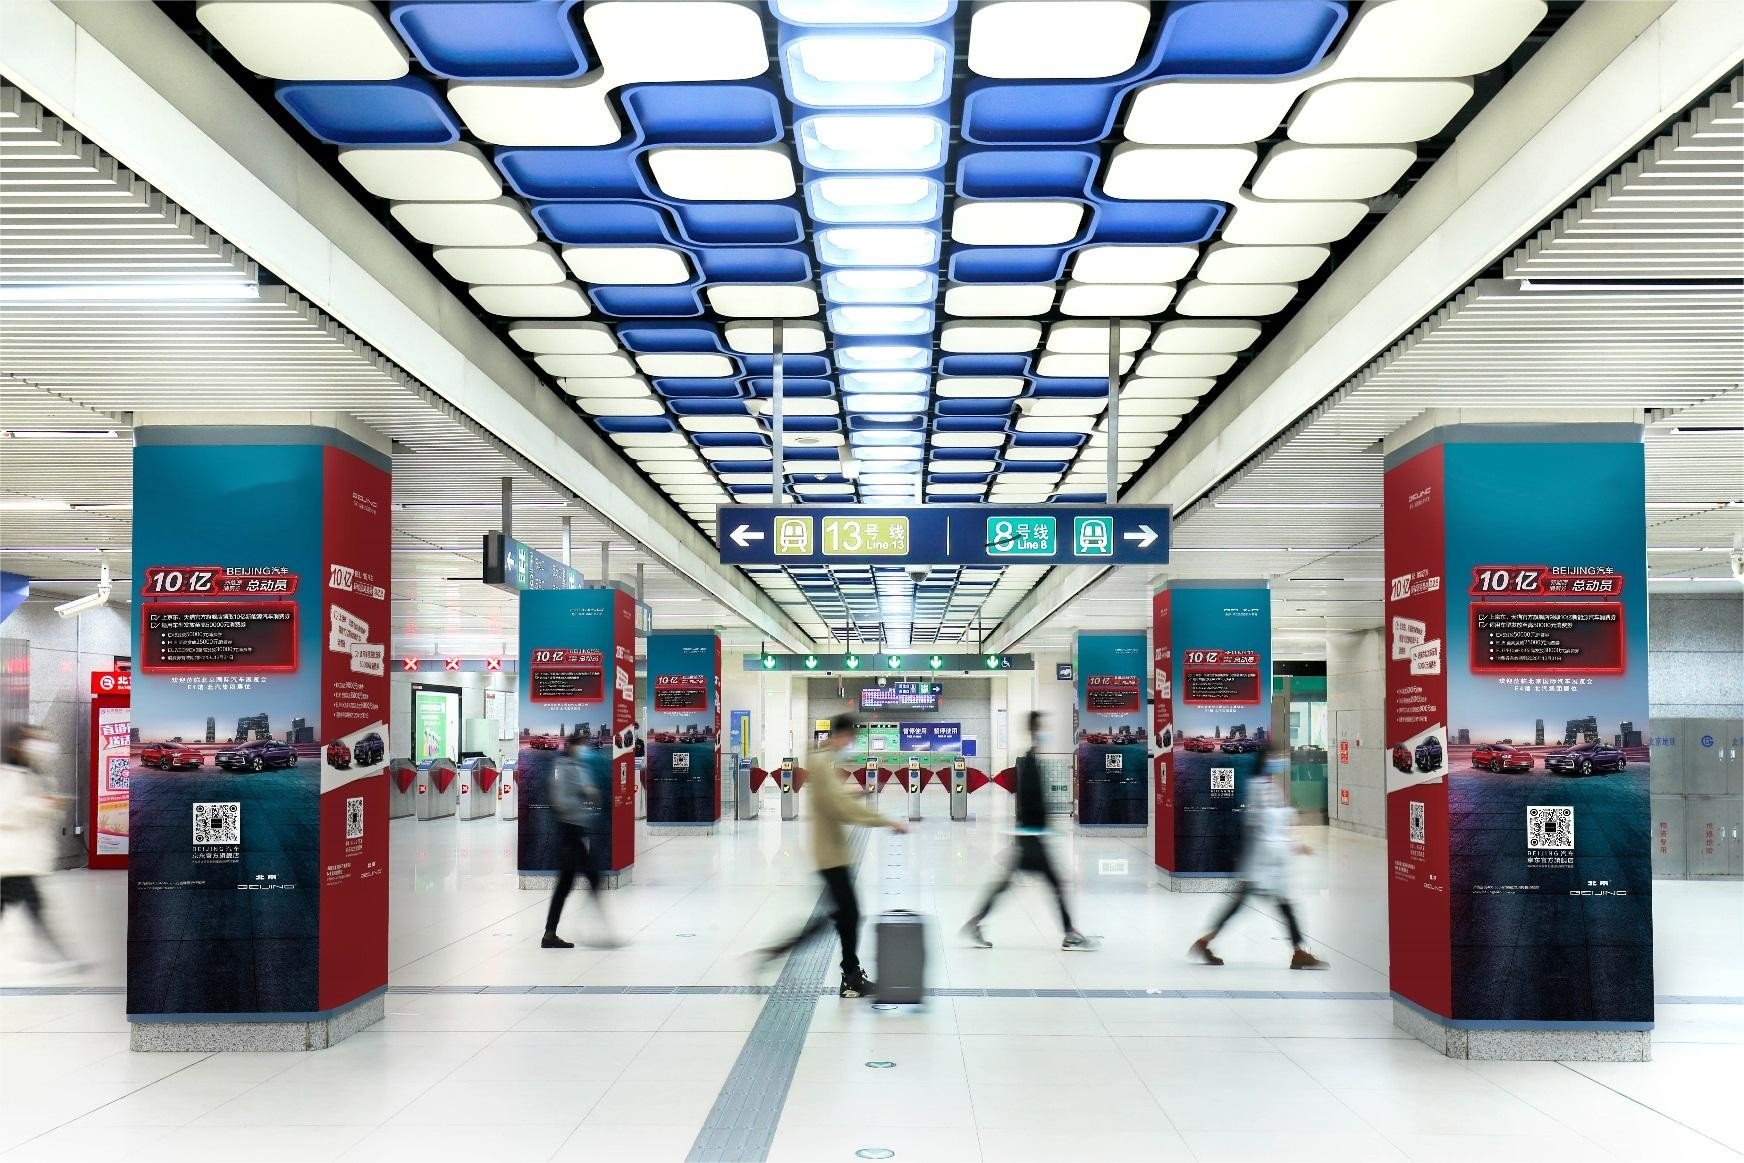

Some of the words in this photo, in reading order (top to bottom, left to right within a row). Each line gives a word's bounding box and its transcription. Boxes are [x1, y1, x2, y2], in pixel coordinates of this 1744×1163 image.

[826, 521, 904, 551] 13号线
[993, 521, 1048, 552] 8号线
[866, 540, 889, 550] Line
[892, 540, 904, 550] 13
[1018, 540, 1039, 550] Line
[153, 571, 212, 592] 10亿
[246, 579, 288, 592] 总动员
[1480, 570, 1538, 591] 10亿
[1571, 579, 1613, 592] 总动员
